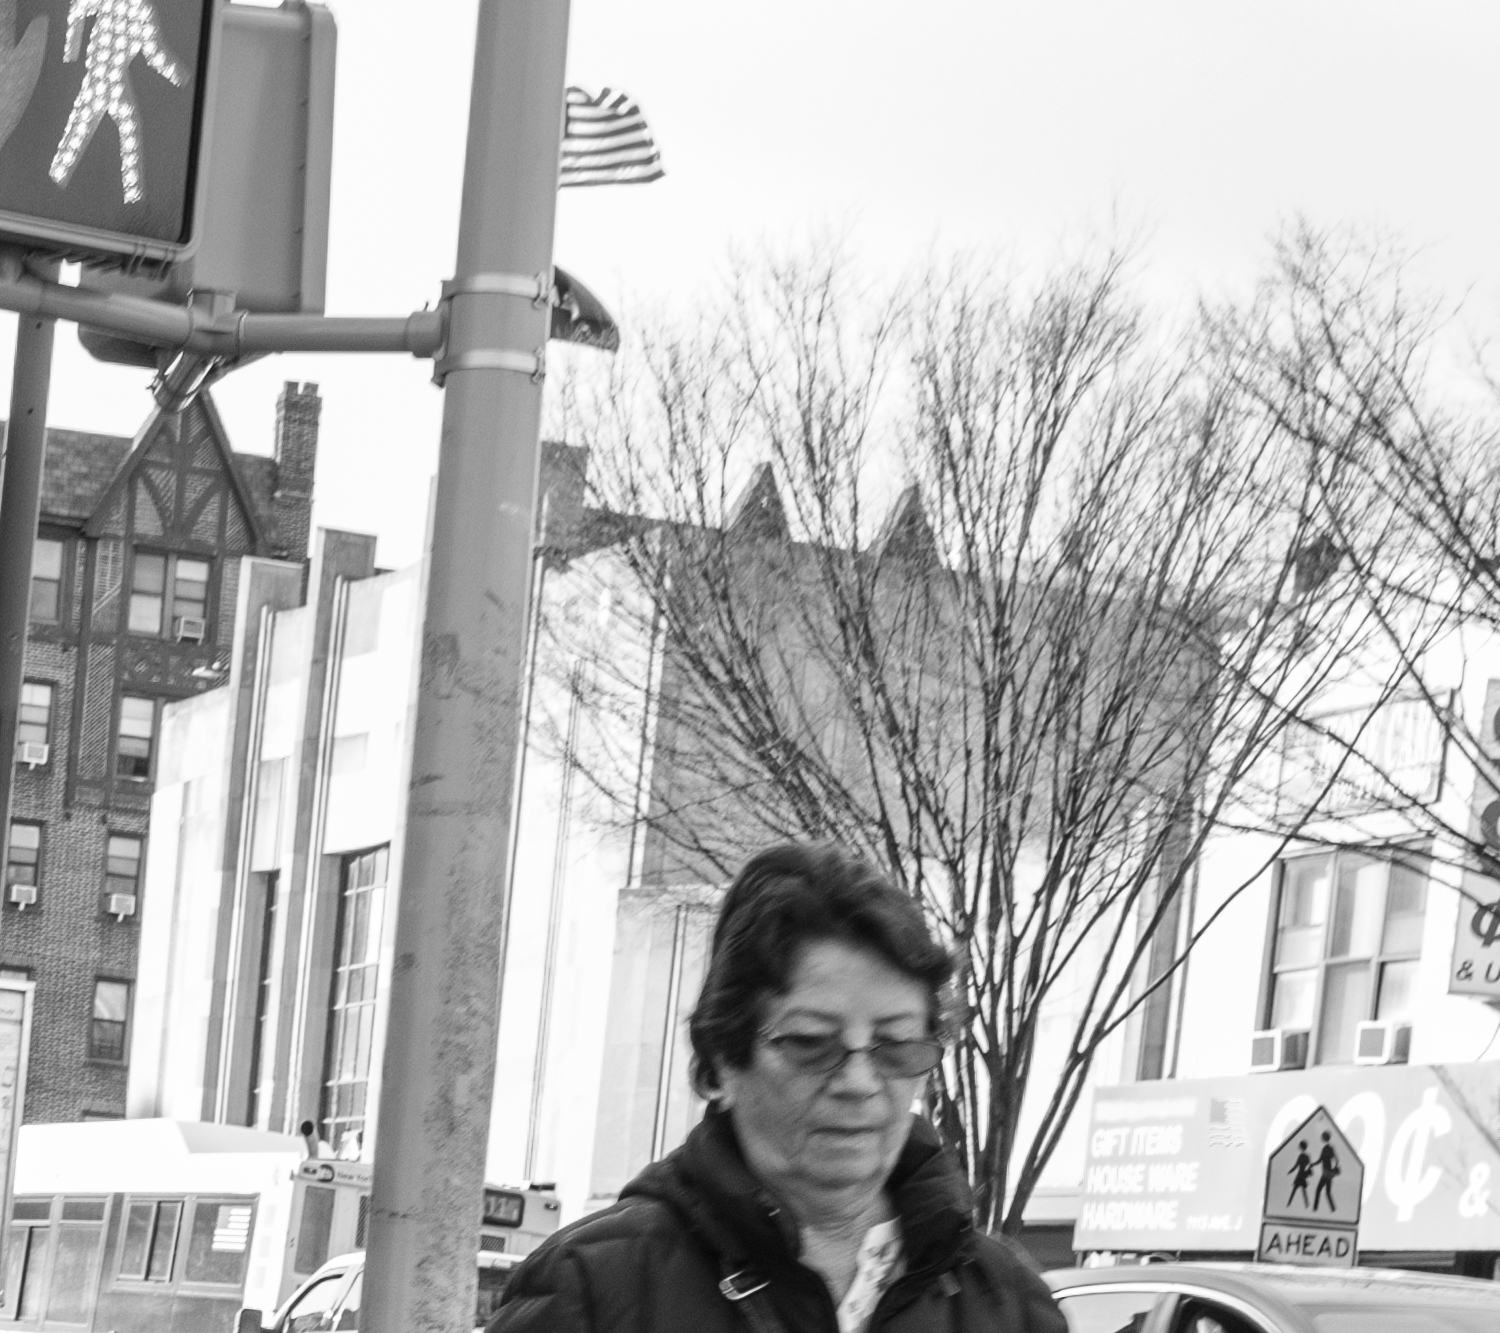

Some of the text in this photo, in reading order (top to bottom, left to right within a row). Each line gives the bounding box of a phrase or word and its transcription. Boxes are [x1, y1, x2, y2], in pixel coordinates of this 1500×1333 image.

[1455, 959, 1475, 983] &
[1087, 1161, 1200, 1194] HOUSE WARE
[1458, 1160, 1491, 1218] &
[1081, 1200, 1179, 1230] HARDWARE
[1265, 1232, 1349, 1259] AHEAD
